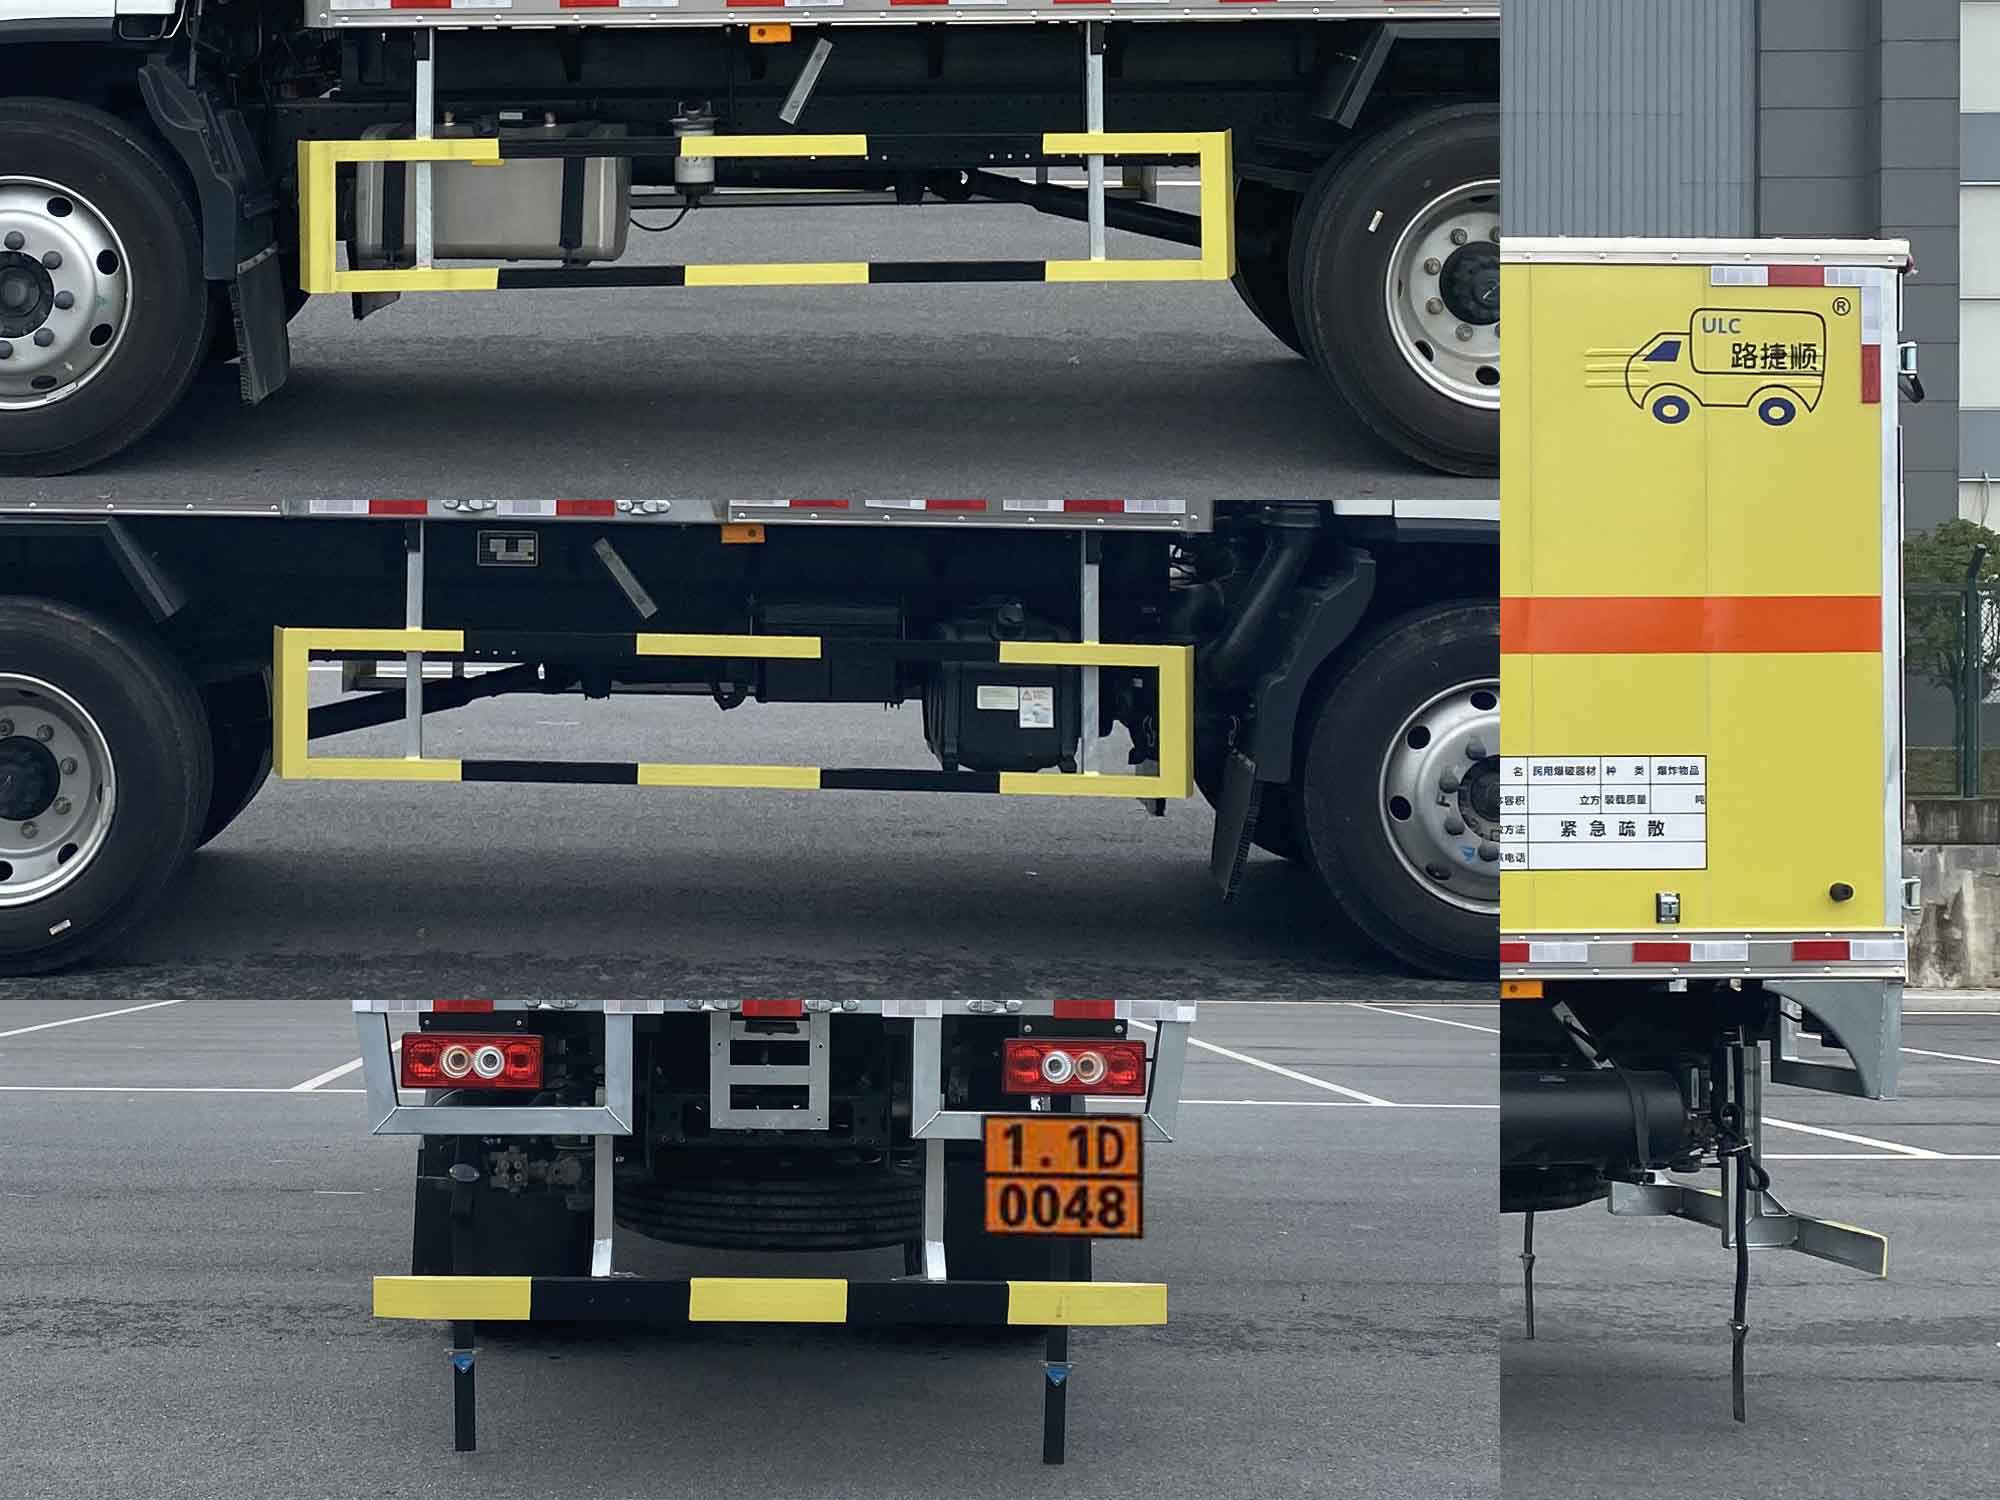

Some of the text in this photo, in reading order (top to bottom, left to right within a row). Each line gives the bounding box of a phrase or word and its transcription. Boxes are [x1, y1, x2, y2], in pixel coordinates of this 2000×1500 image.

[1702, 318, 1741, 334] ULC
[1731, 342, 1817, 371] 路捷顺
[1513, 766, 1523, 777] 名
[1532, 766, 1597, 777] 民用爆破器材
[1657, 765, 1700, 776] 爆炸物品
[1579, 795, 1600, 806] 立方
[1604, 794, 1647, 805] 装载质量
[1560, 820, 1665, 837] 紧急疏散
[1004, 1124, 1124, 1168] 1.1D
[999, 1183, 1126, 1229] 0048
